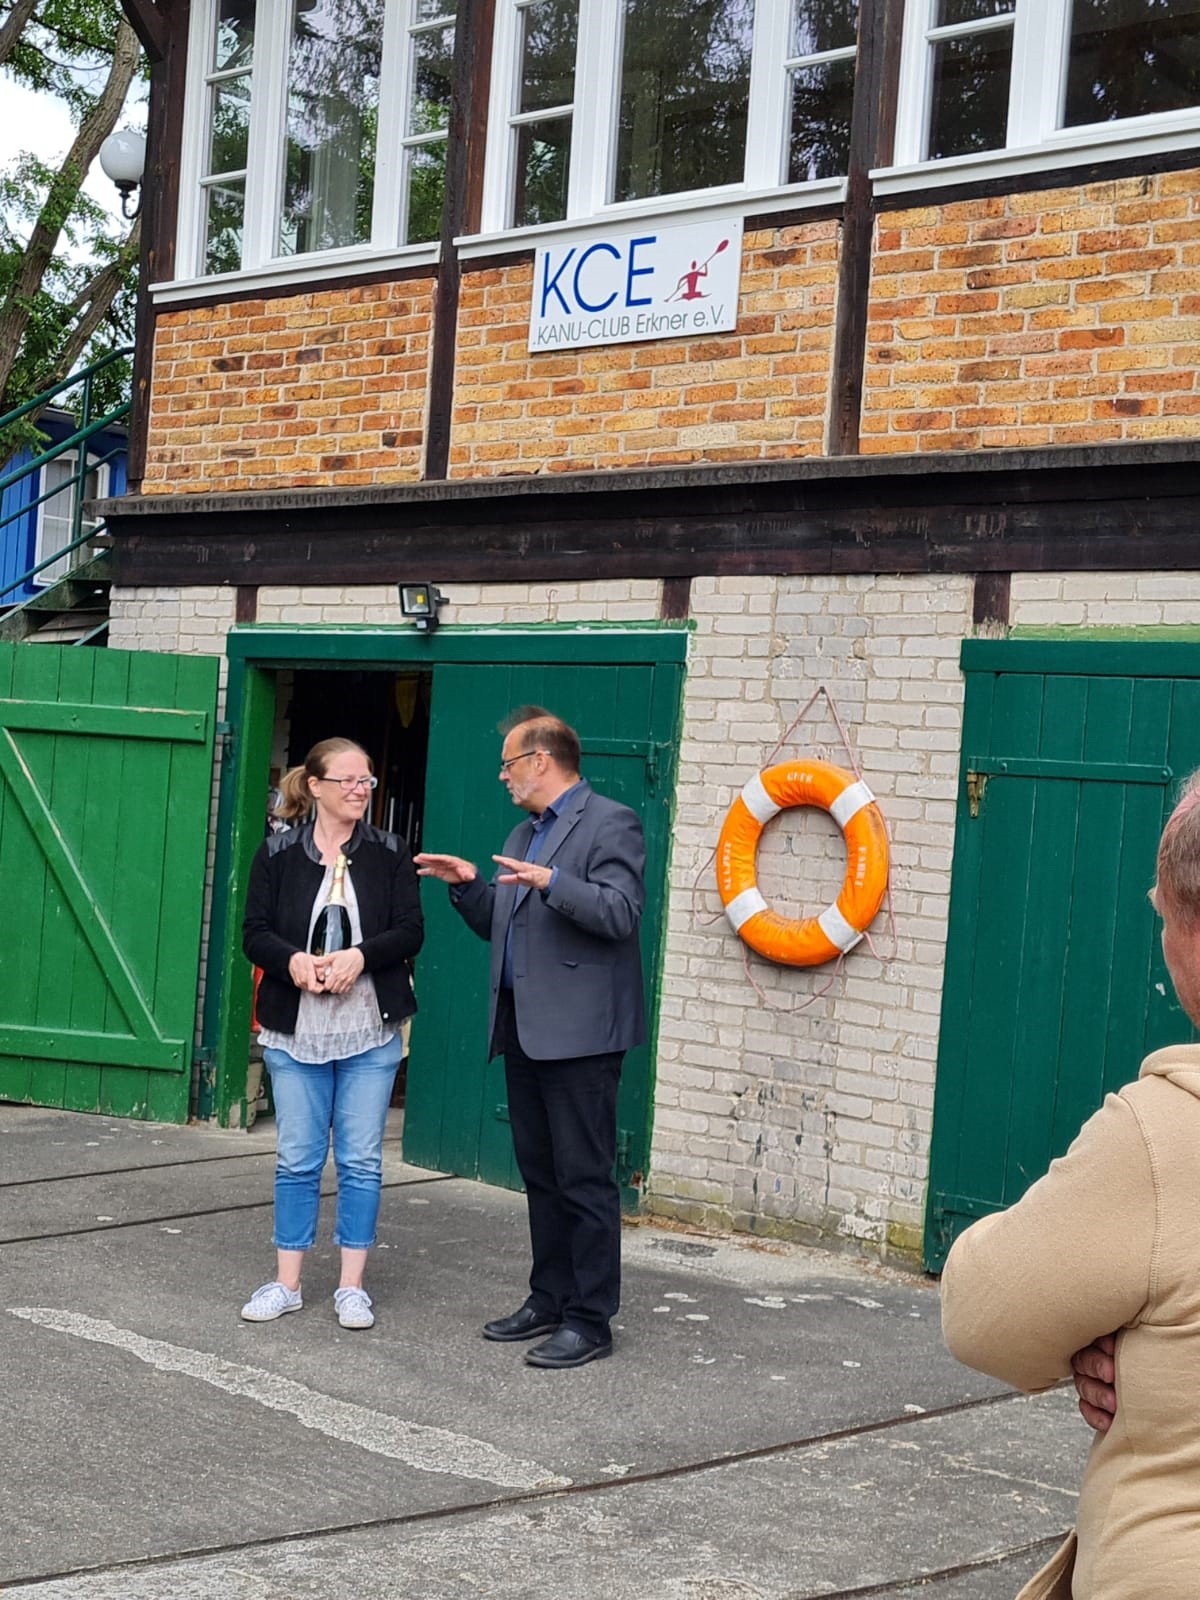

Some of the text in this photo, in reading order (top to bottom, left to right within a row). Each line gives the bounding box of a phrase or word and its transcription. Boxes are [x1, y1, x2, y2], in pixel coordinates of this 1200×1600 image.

[540, 235, 657, 318] KCE
[537, 315, 630, 345] KANU-CLUB
[635, 312, 688, 334] Erkner
